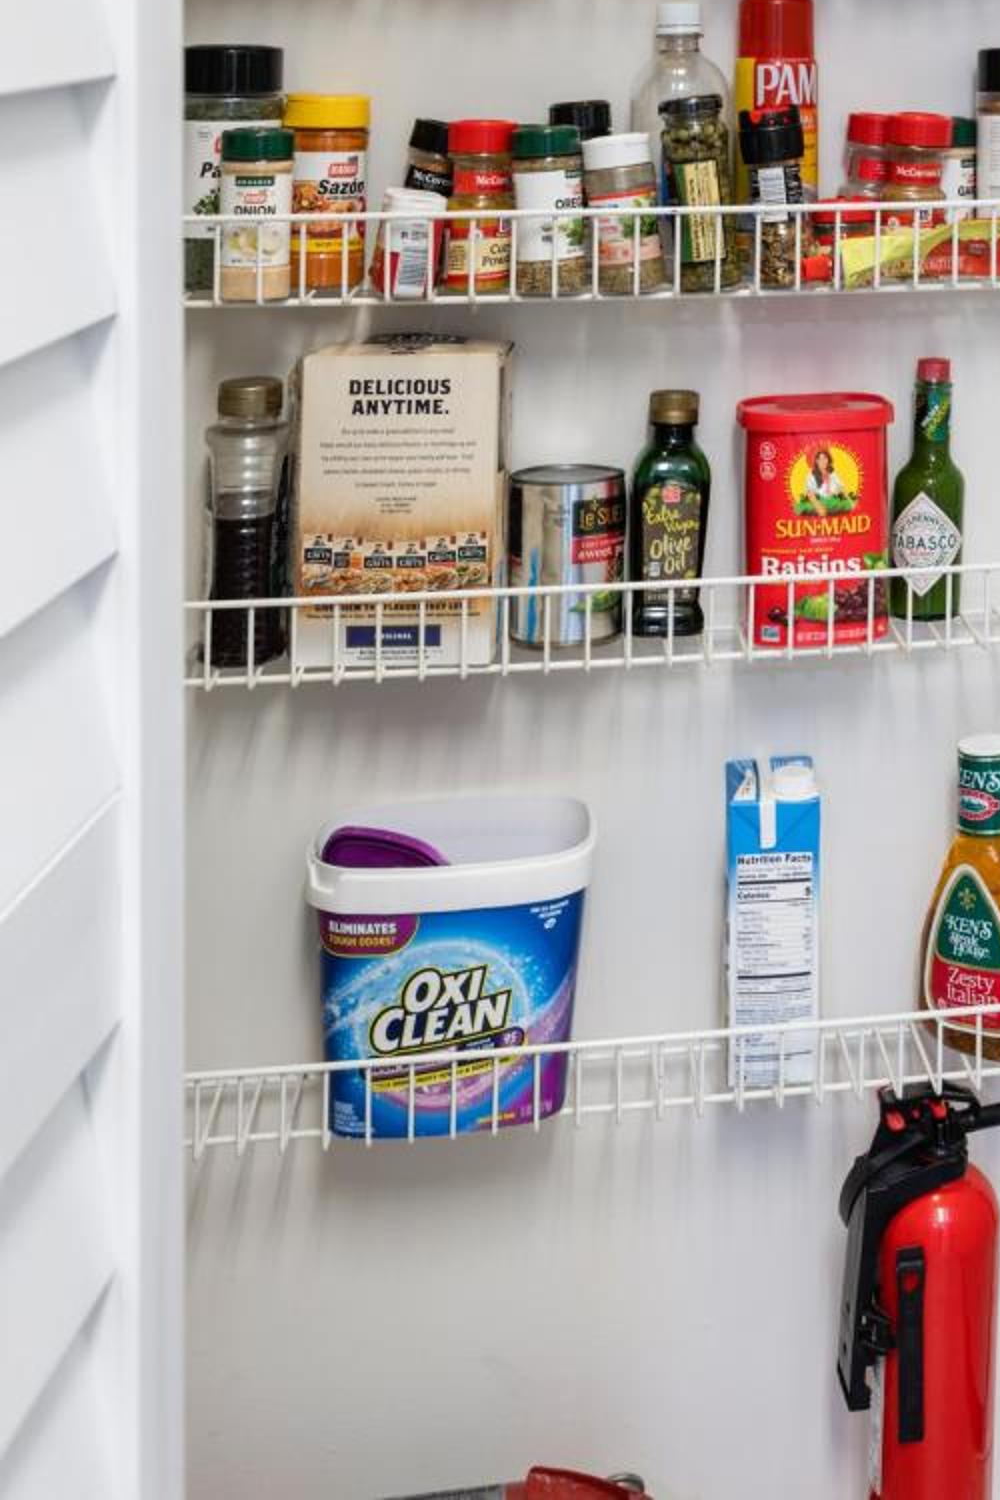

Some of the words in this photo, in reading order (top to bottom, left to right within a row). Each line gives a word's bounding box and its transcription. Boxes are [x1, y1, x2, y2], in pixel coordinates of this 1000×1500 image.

[756, 63, 817, 107] PAM
[233, 204, 277, 216] ONION
[349, 378, 452, 396] DELICIOUS
[351, 398, 450, 416] ANYTIME.
[649, 532, 692, 560] Olive
[892, 532, 957, 550] TABASCO
[663, 550, 686, 575] Oil
[761, 552, 862, 577] Raisins
[737, 855, 783, 866] Nutrition
[785, 852, 812, 864] Facts
[328, 920, 398, 935] ELIMINATES
[944, 912, 993, 942] KEN'S
[402, 965, 488, 1017] OXI
[947, 966, 995, 995] Zesty
[946, 982, 1000, 1006] Italian
[369, 990, 512, 1056] CLEAN
